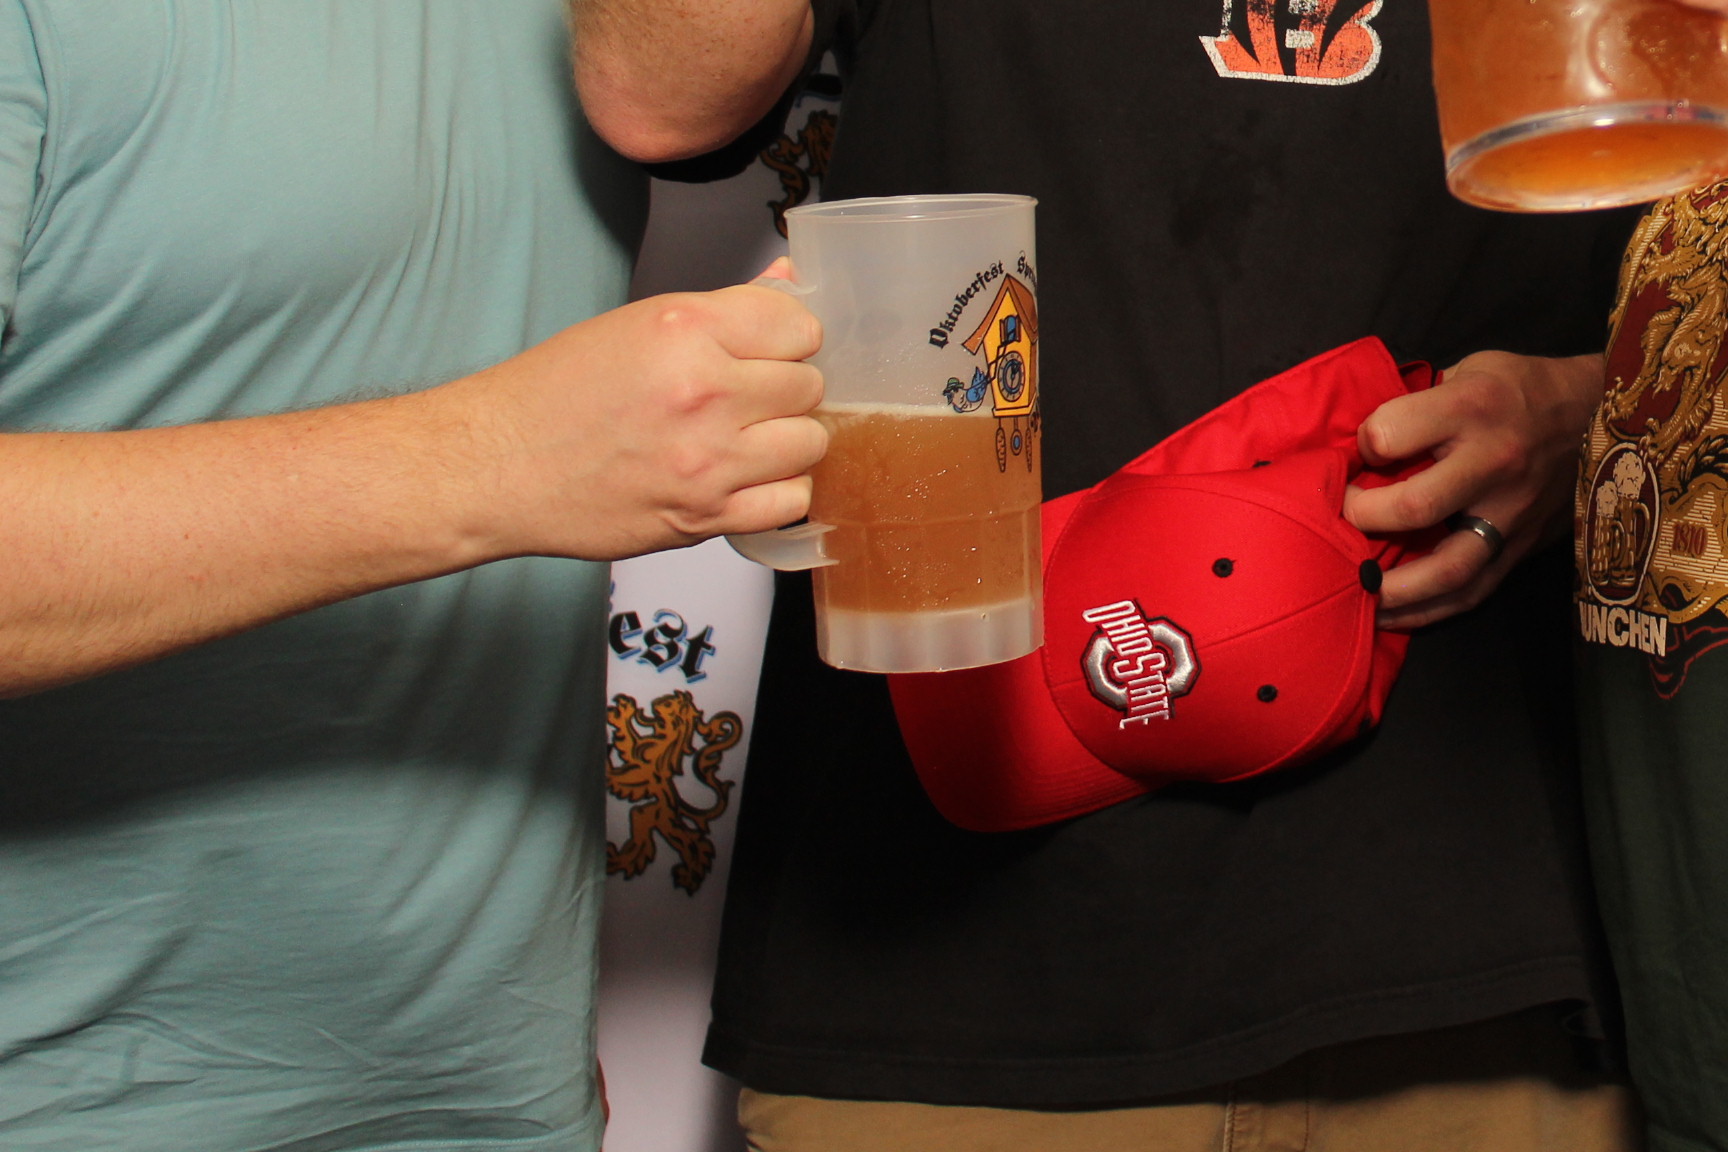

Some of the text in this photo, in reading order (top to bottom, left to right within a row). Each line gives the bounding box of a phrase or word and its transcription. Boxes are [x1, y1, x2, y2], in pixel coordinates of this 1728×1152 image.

[929, 259, 1005, 349] Oktoberfest
[1672, 523, 1708, 555] 1810
[1082, 600, 1170, 730] OHIO STATE
